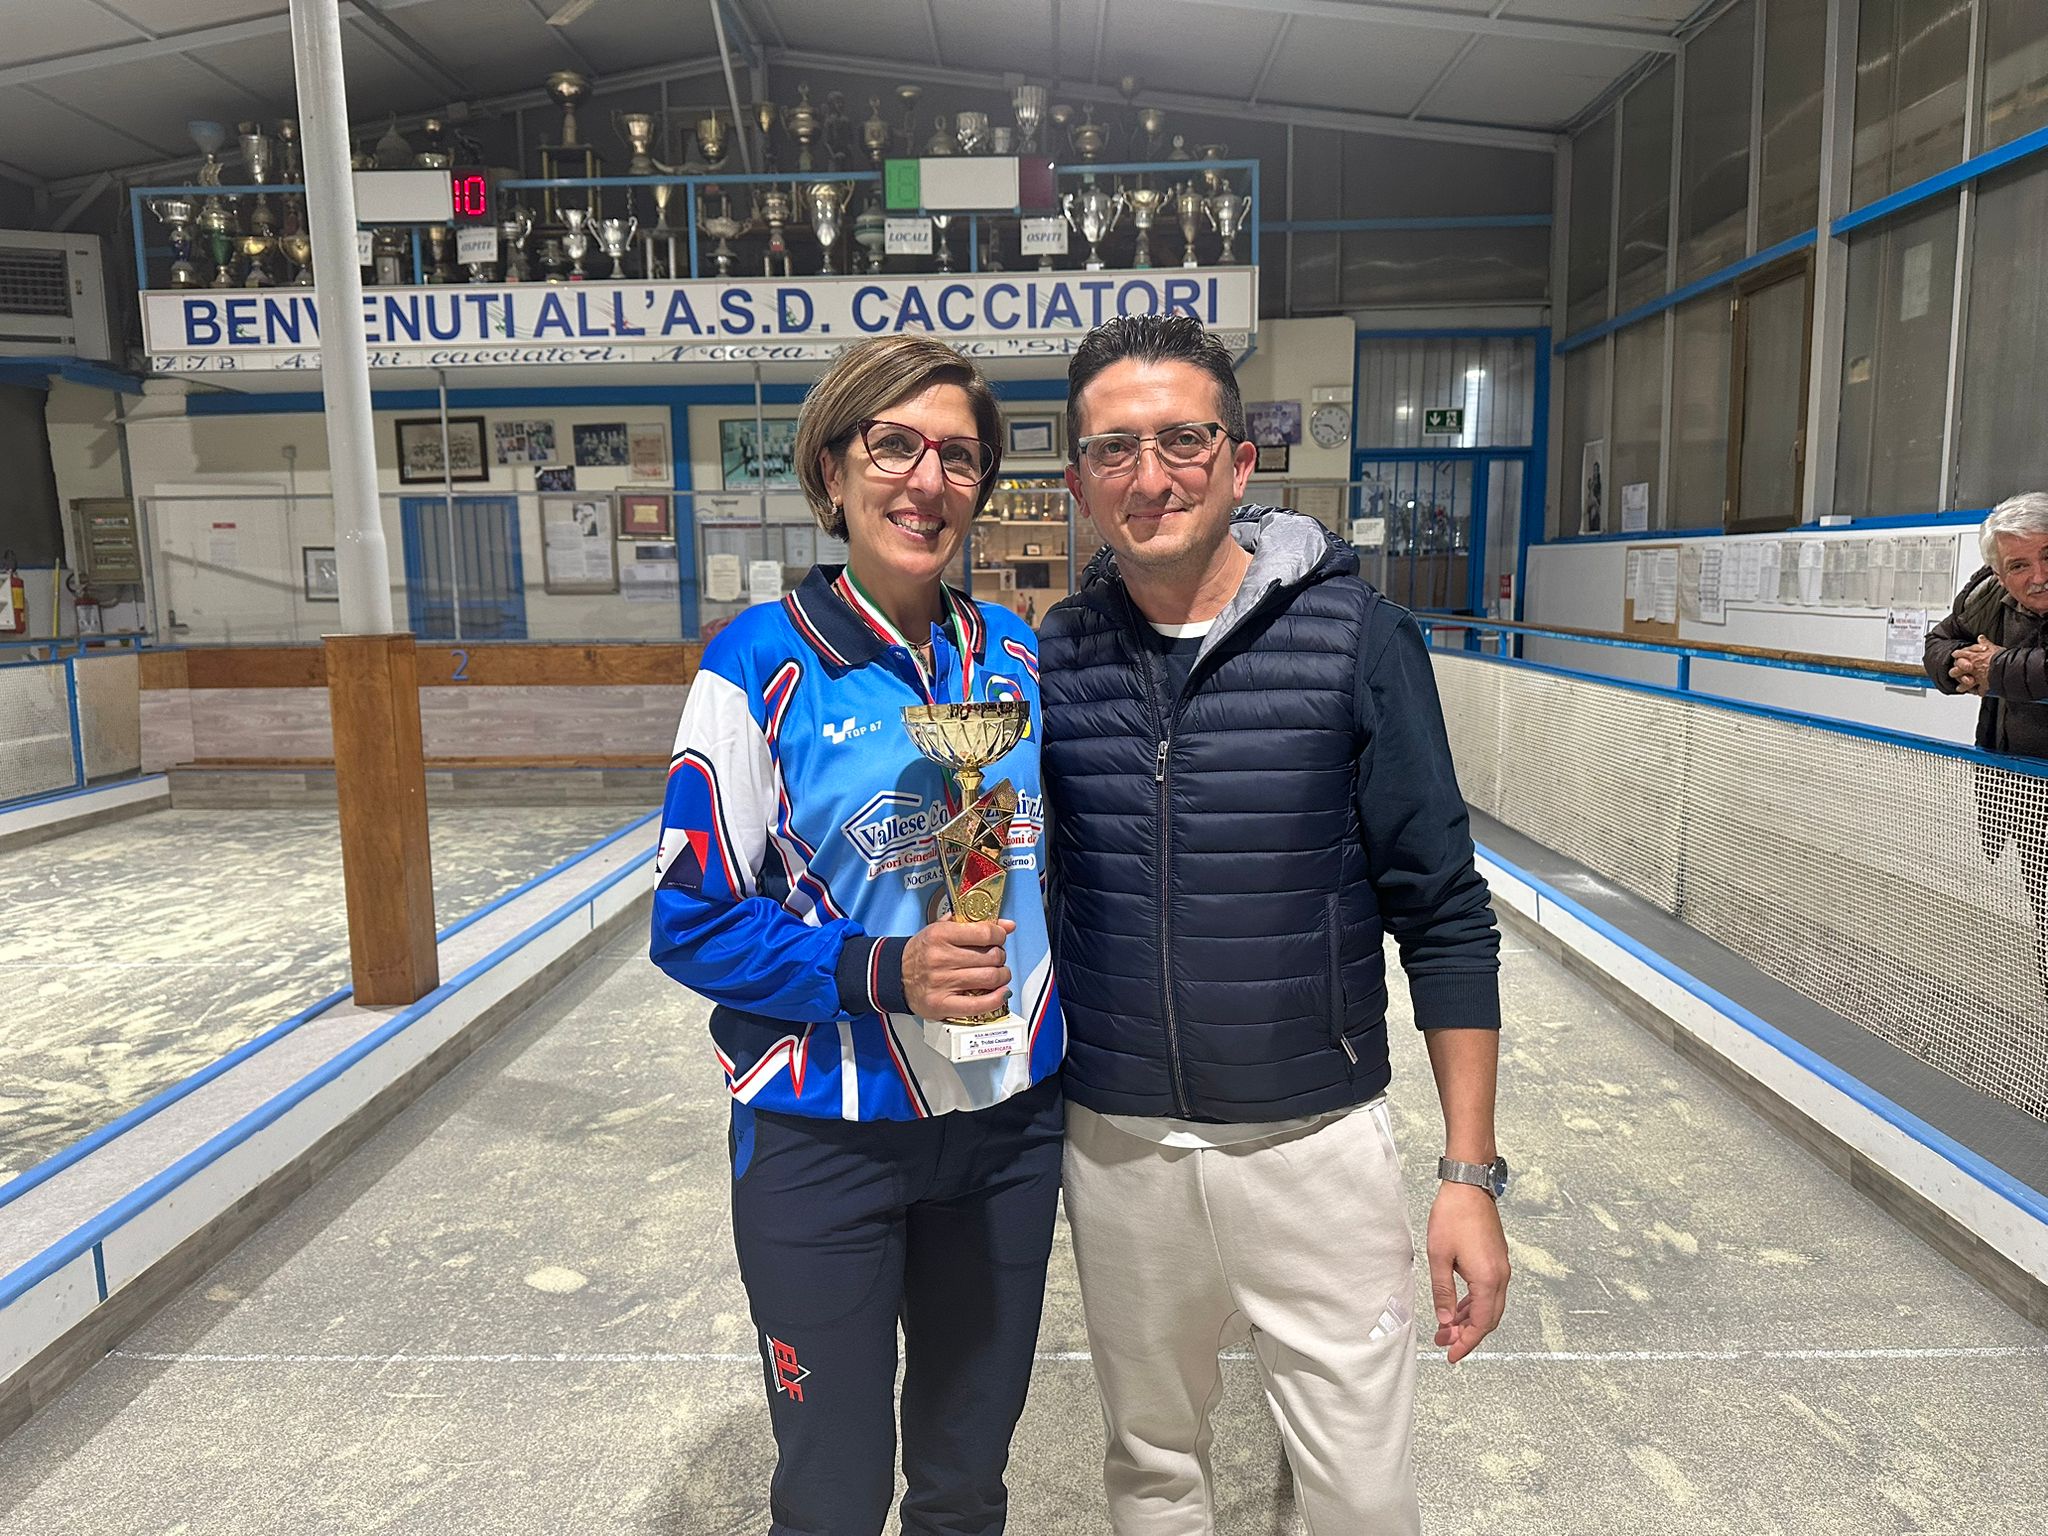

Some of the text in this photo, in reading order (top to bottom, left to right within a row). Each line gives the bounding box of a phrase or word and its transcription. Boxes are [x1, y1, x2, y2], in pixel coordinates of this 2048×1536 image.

[453, 175, 486, 215] 10
[889, 229, 928, 243] LOCALI
[1026, 230, 1062, 243] OSPITI
[852, 277, 1217, 333] CACCIATORI
[451, 649, 469, 681] 2
[845, 726, 867, 739] TOP
[860, 813, 927, 848] Vallese
